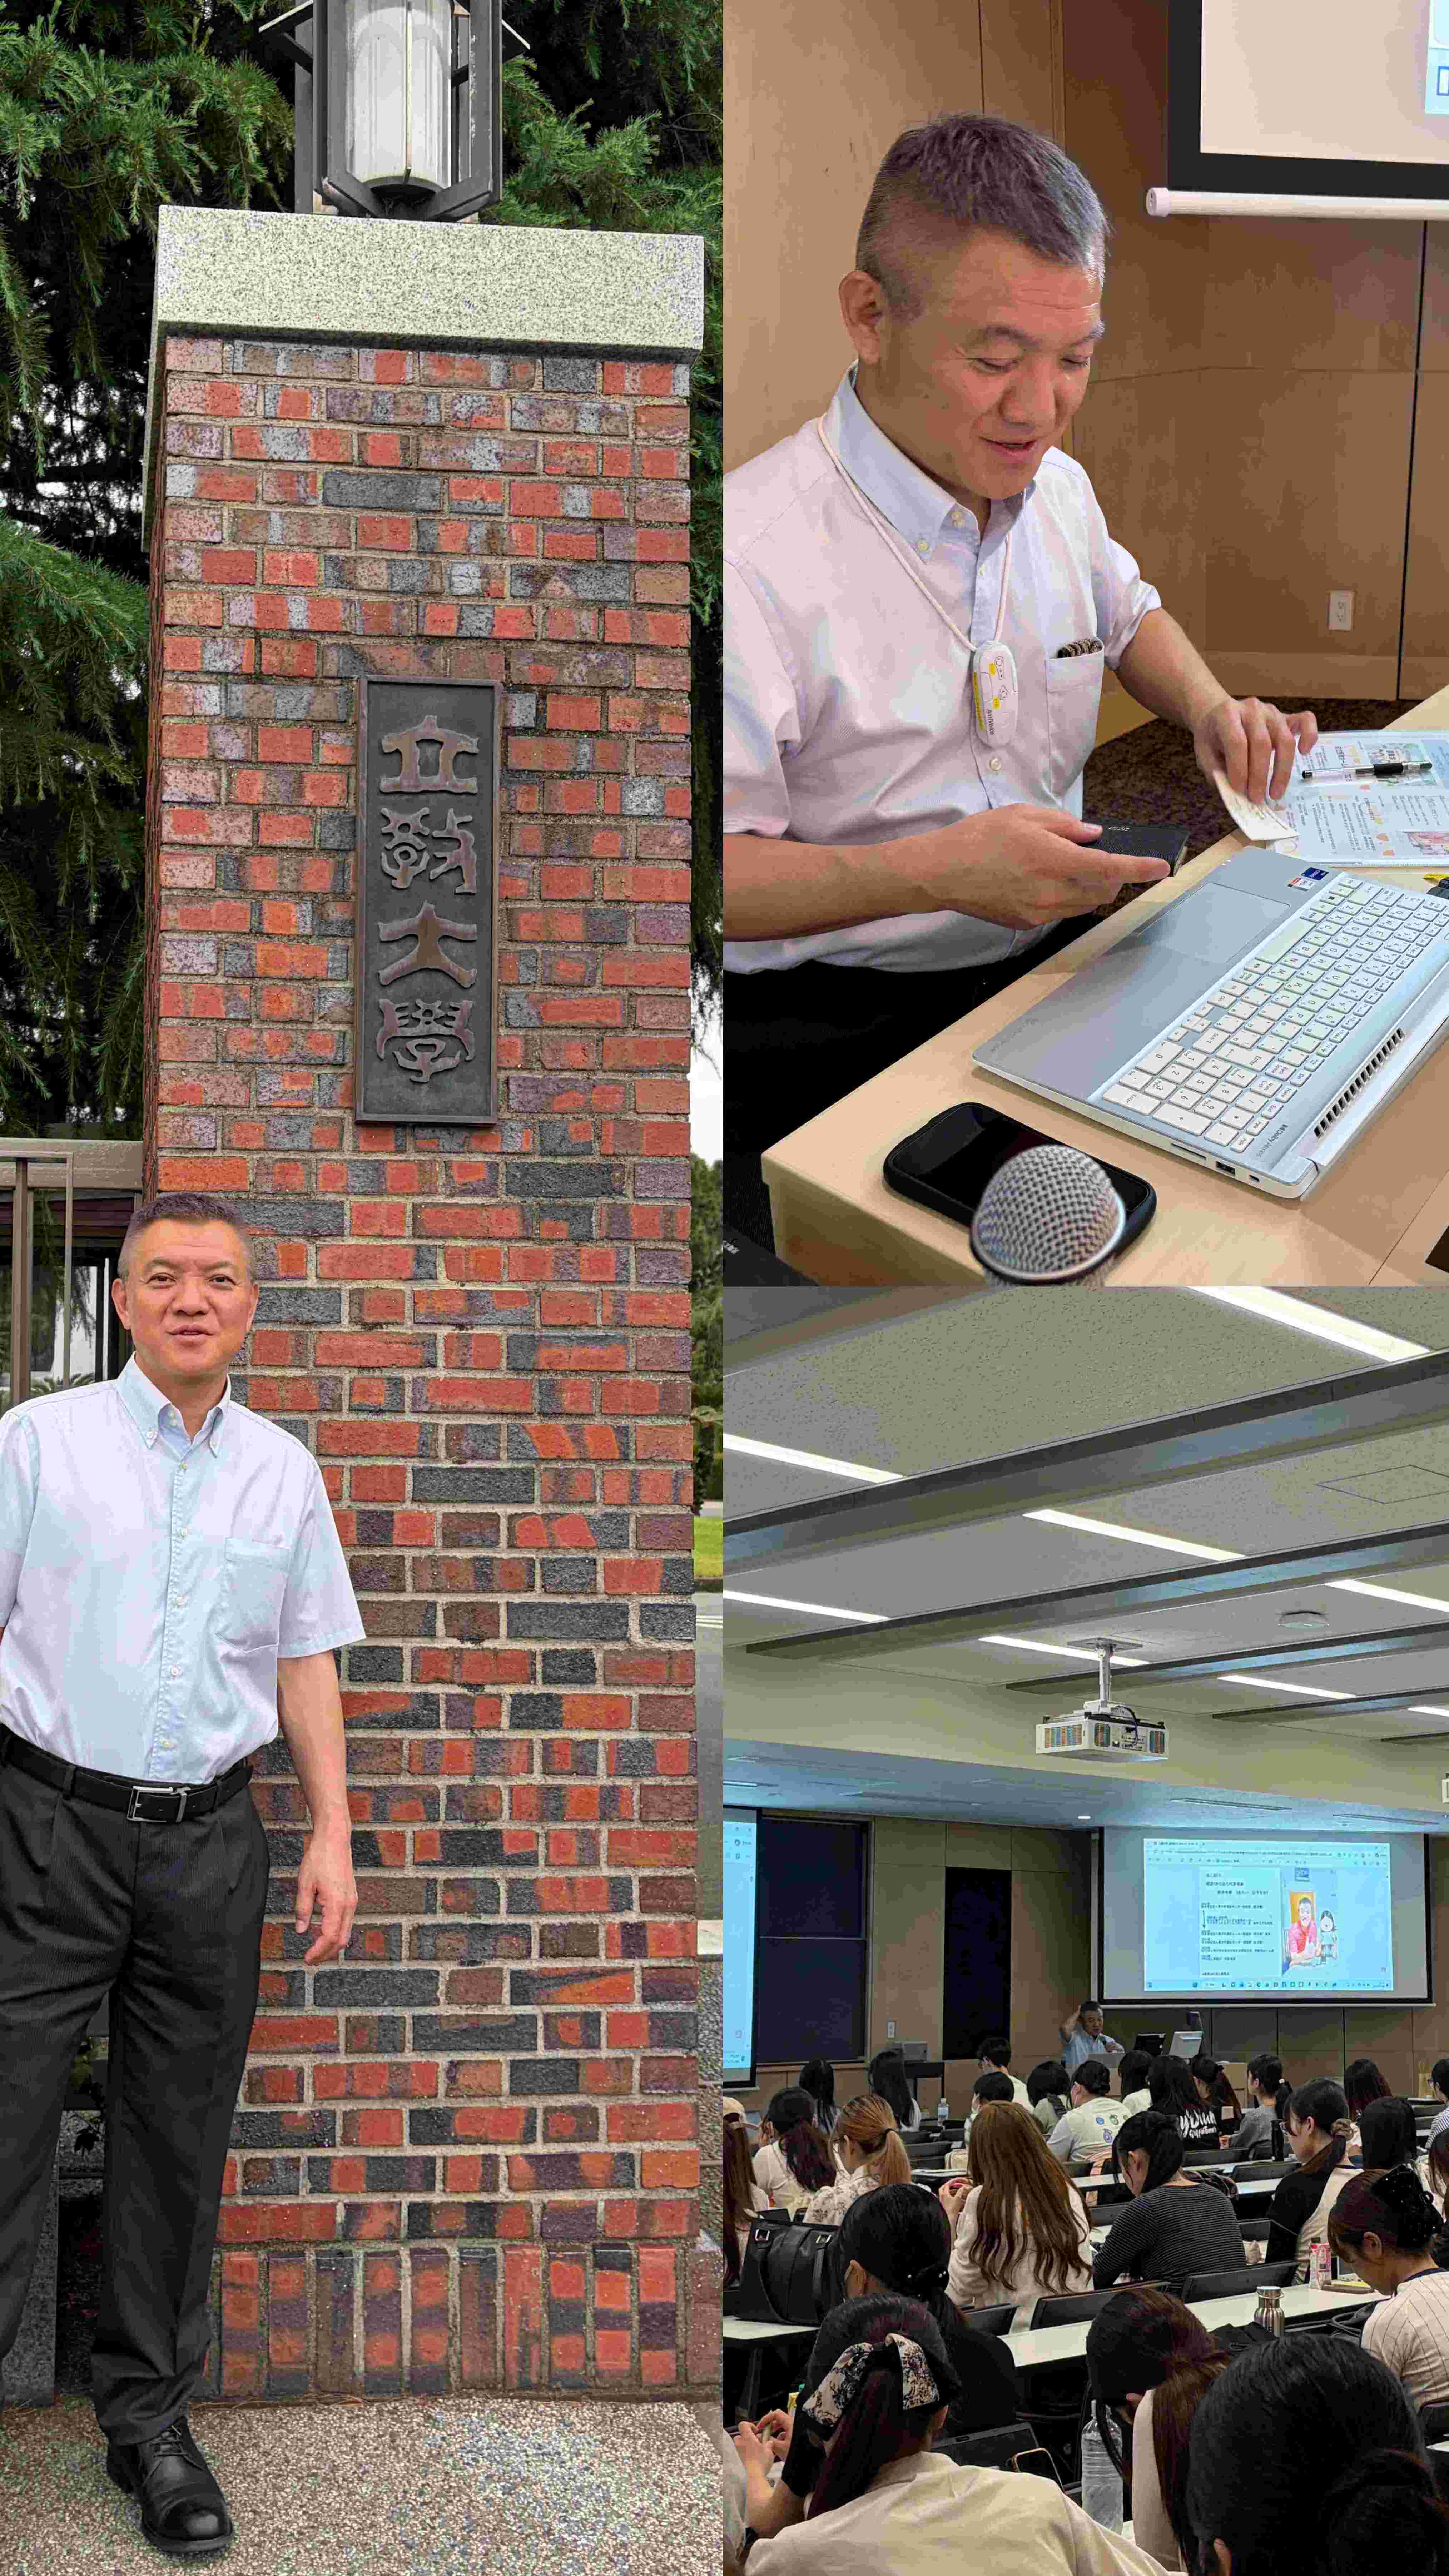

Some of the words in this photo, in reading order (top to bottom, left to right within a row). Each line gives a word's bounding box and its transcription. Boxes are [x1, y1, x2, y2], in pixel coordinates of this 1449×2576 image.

[987, 709, 995, 735] AmiVoice
[1250, 1055, 1261, 1065] Enter
[1268, 1129, 1283, 1143] Dolby
